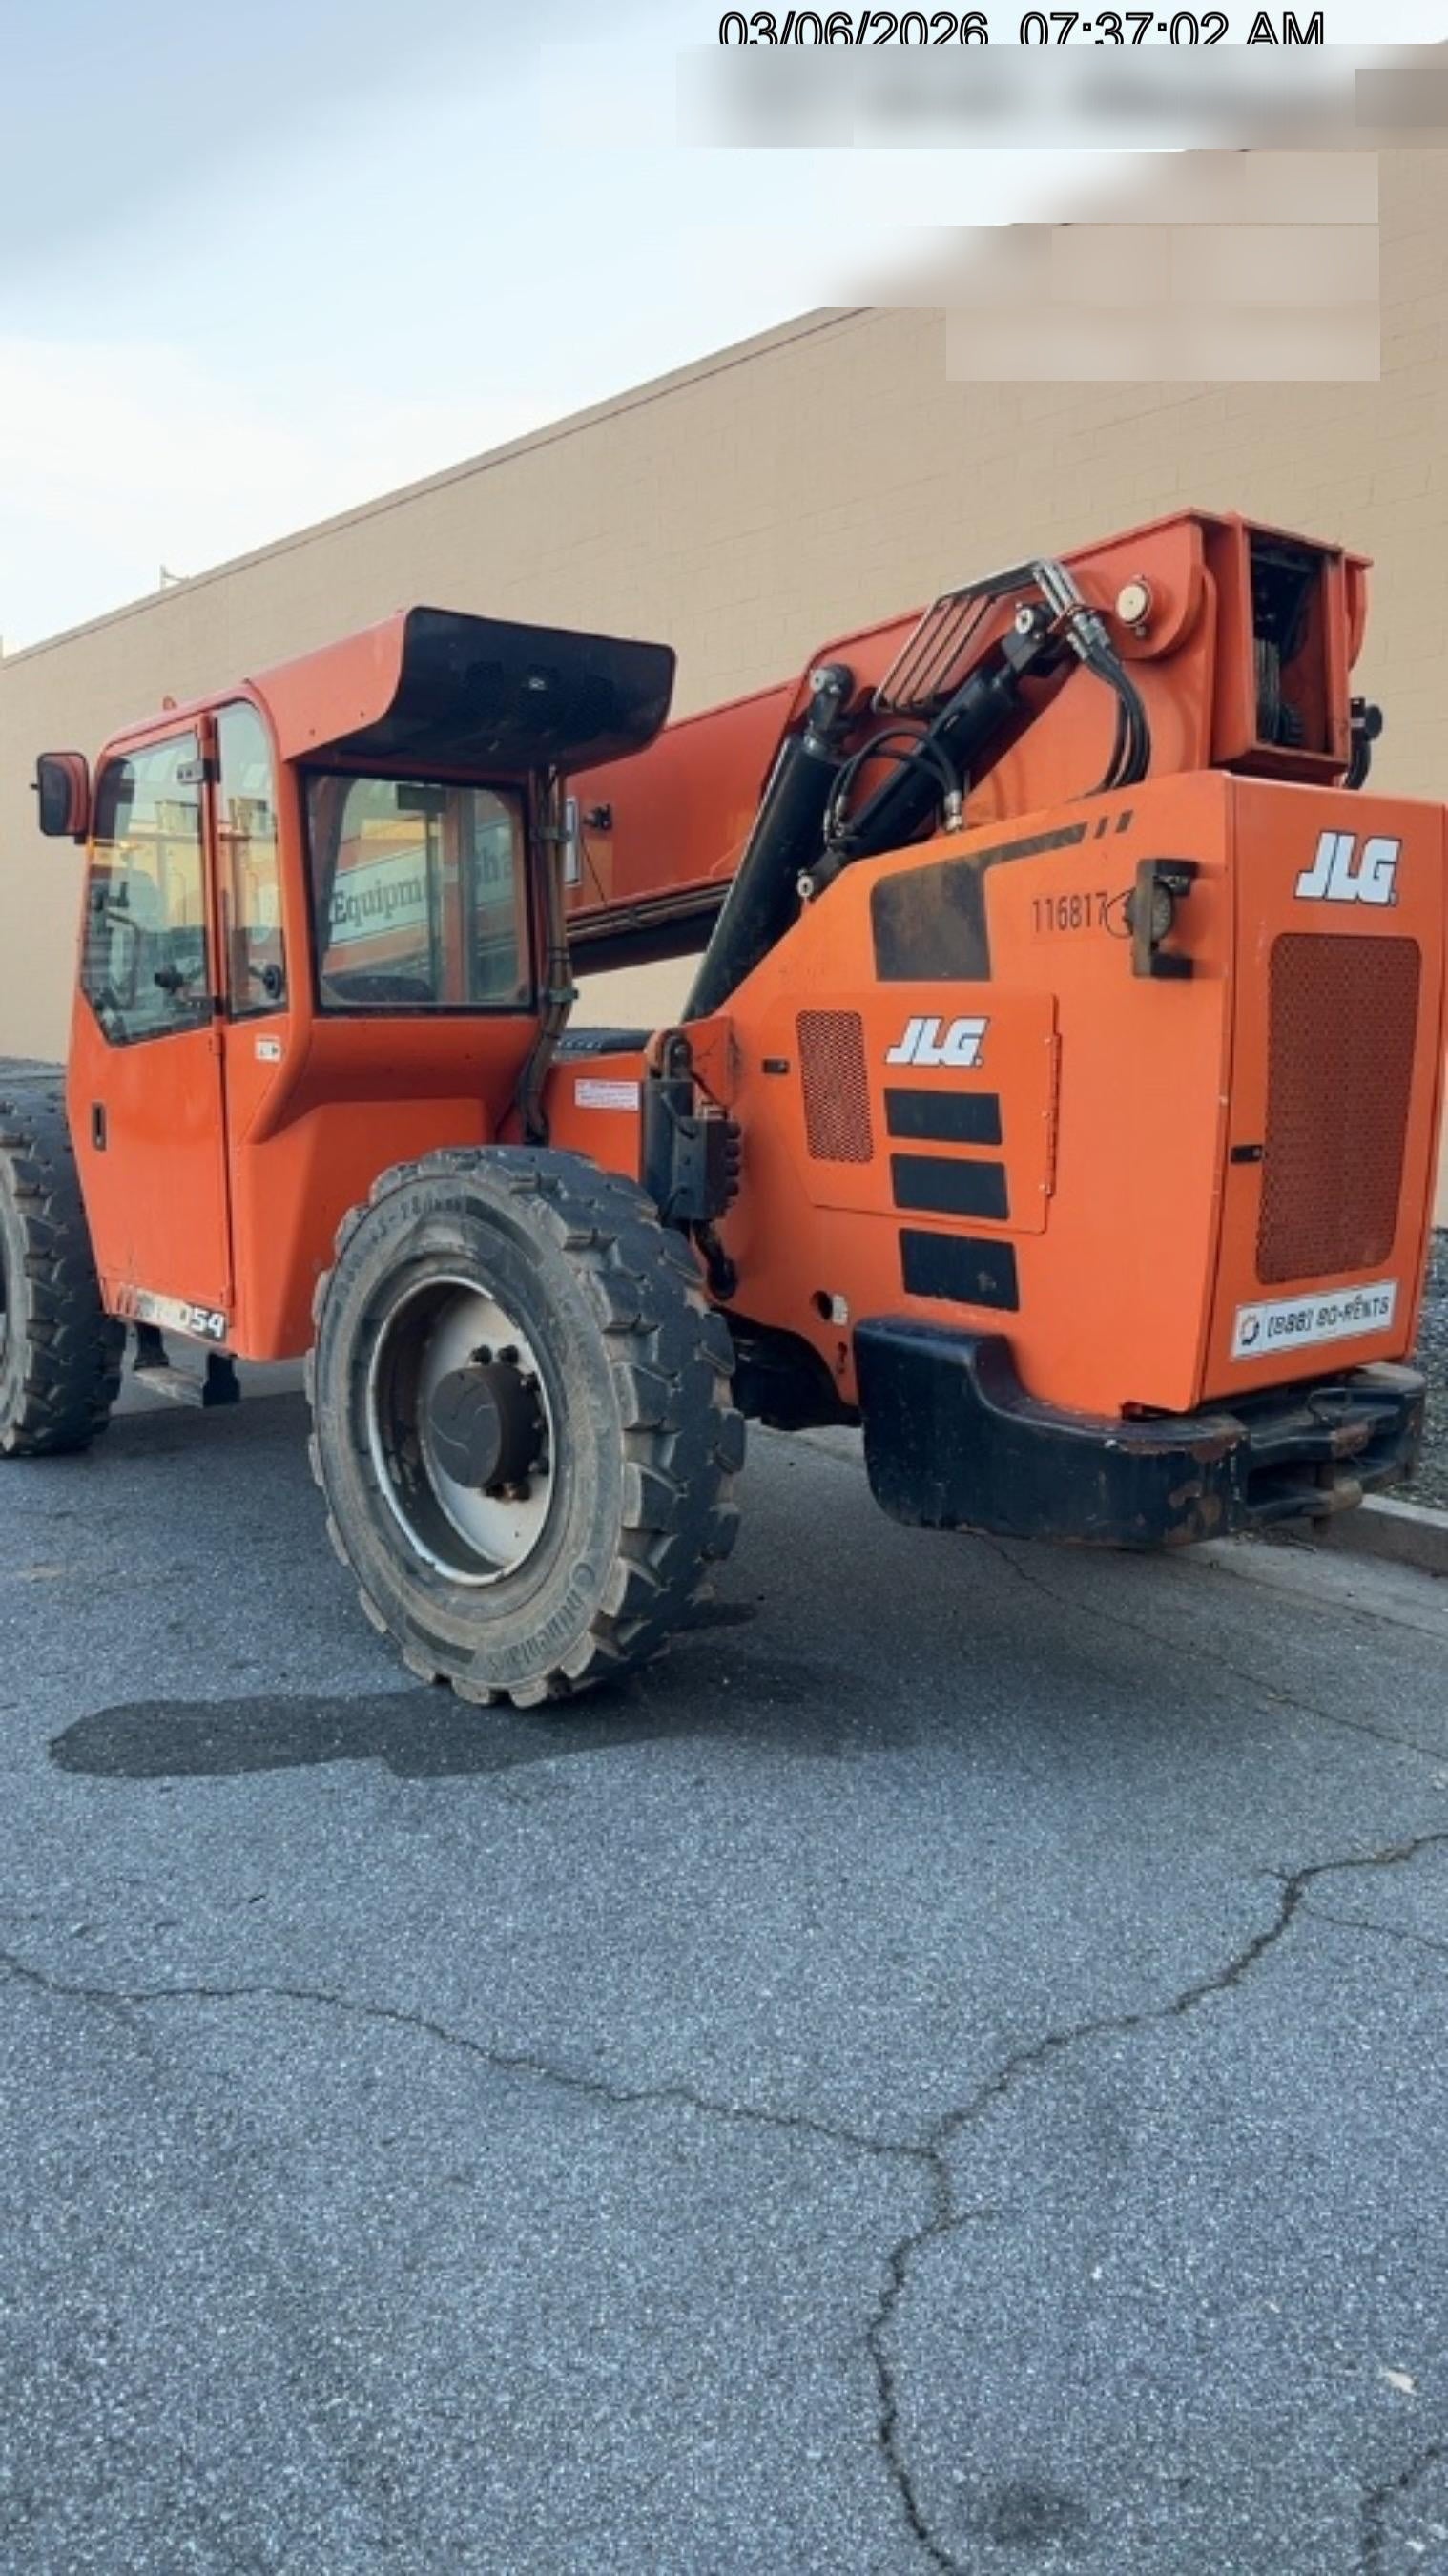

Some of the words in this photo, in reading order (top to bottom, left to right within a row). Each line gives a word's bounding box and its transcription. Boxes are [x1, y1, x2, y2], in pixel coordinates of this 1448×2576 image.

[1294, 830, 1402, 906] JLG
[1032, 891, 1107, 933] 116817
[884, 1015, 990, 1068] JLG
